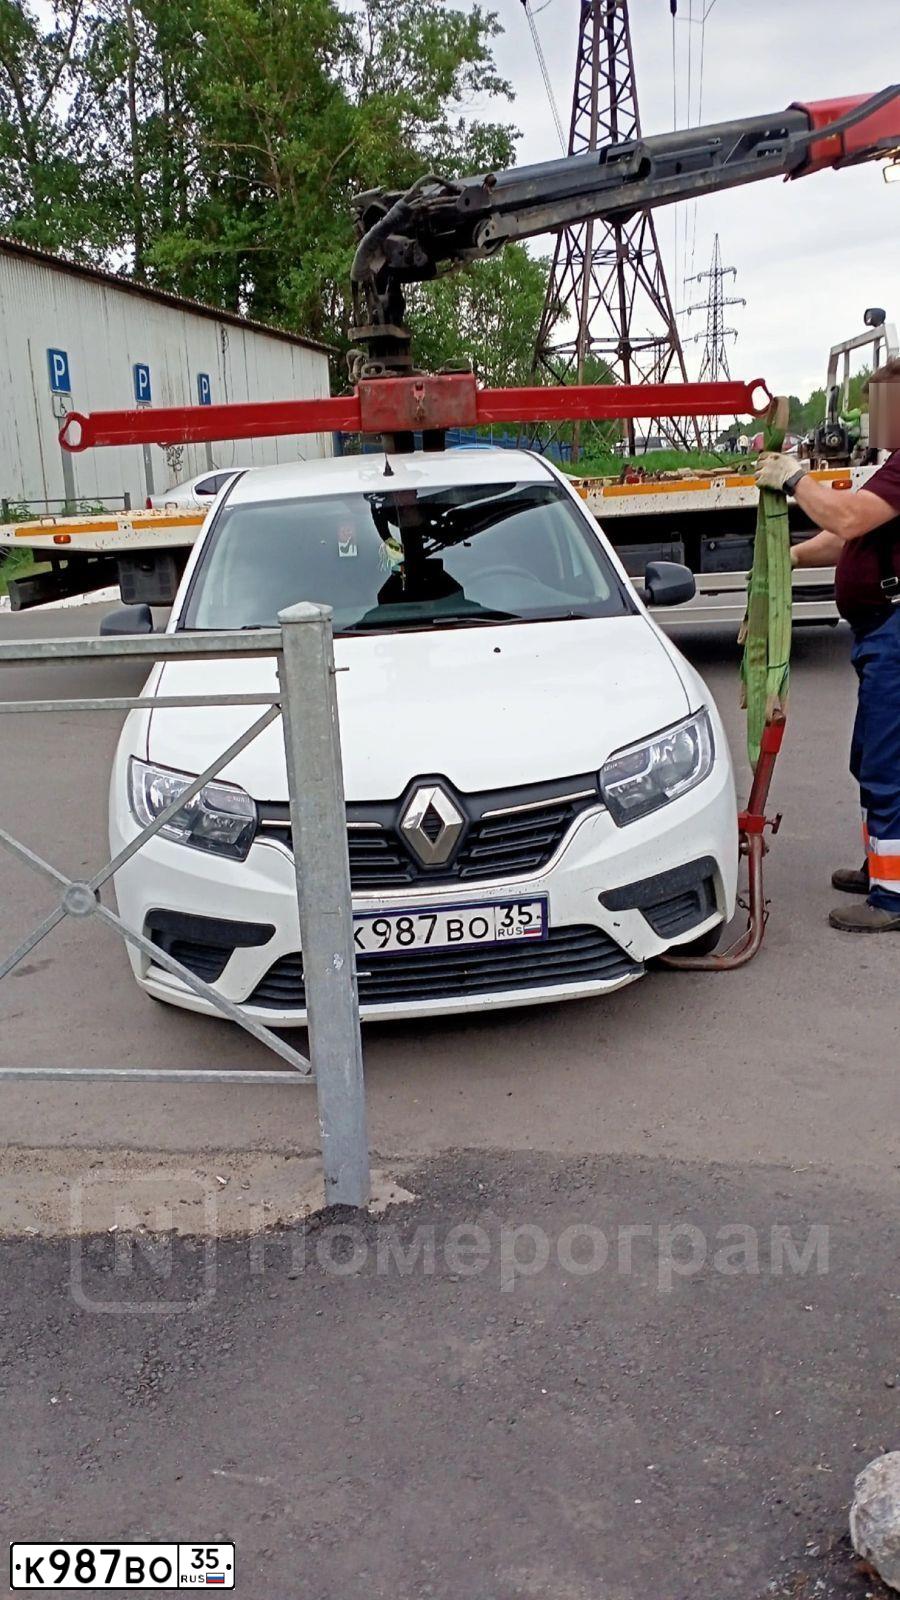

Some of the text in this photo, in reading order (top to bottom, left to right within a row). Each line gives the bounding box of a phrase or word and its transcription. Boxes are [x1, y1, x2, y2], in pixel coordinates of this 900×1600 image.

[53, 354, 66, 387] P
[138, 368, 148, 397] P
[201, 377, 209, 403] P
[499, 903, 533, 928] 35
[497, 926, 523, 937] RUS
